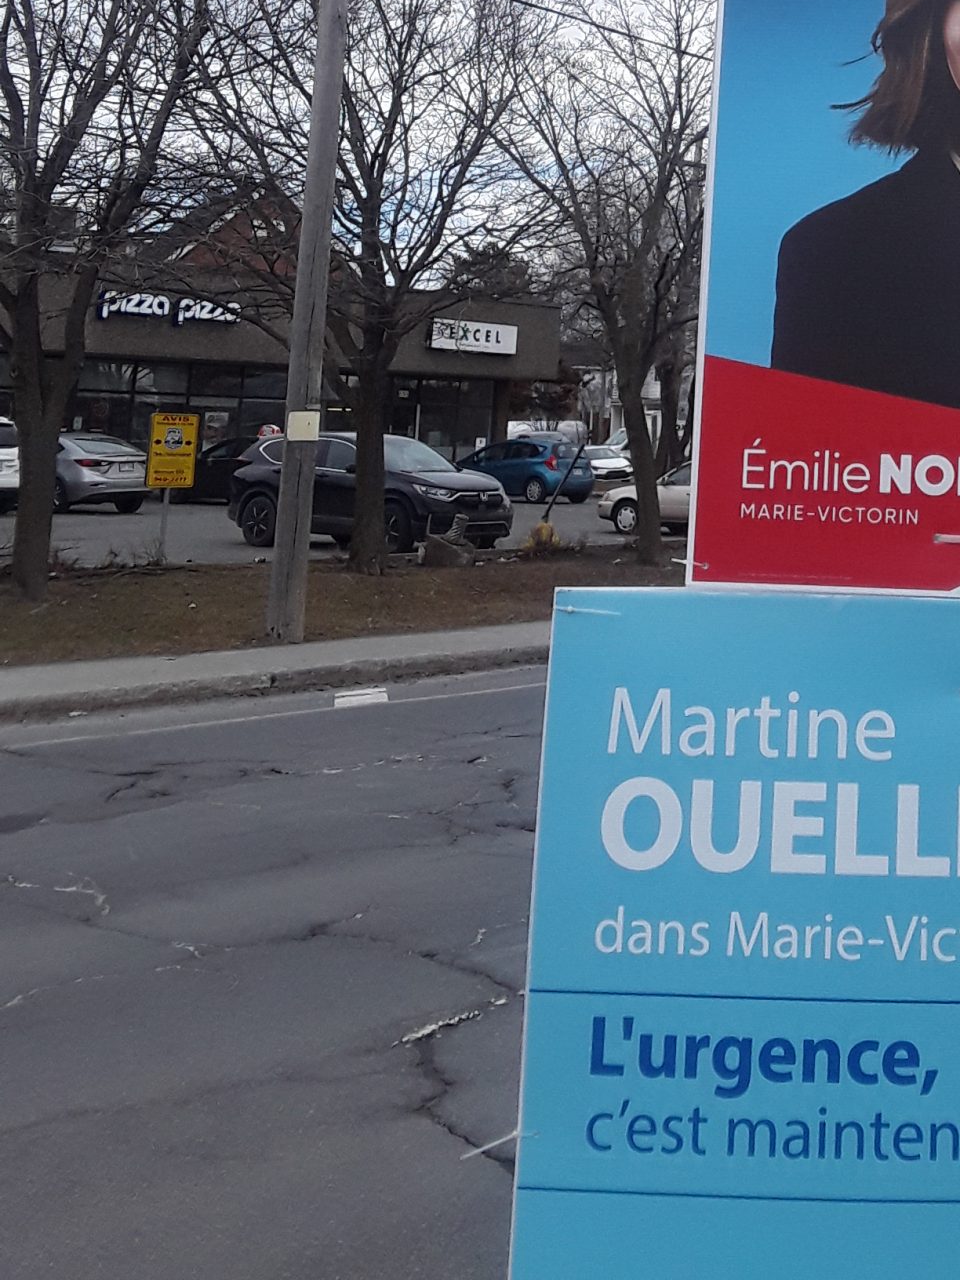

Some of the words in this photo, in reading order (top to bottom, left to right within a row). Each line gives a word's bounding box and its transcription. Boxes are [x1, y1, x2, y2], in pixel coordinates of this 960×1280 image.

[101, 290, 170, 319] pizza
[741, 438, 871, 494] Émilie
[739, 503, 920, 525] MARIE-VICTORIN
[606, 686, 896, 761] Martine
[593, 905, 710, 957] dans
[589, 1015, 939, 1099] L'urgence,
[585, 1099, 708, 1155] c'est
